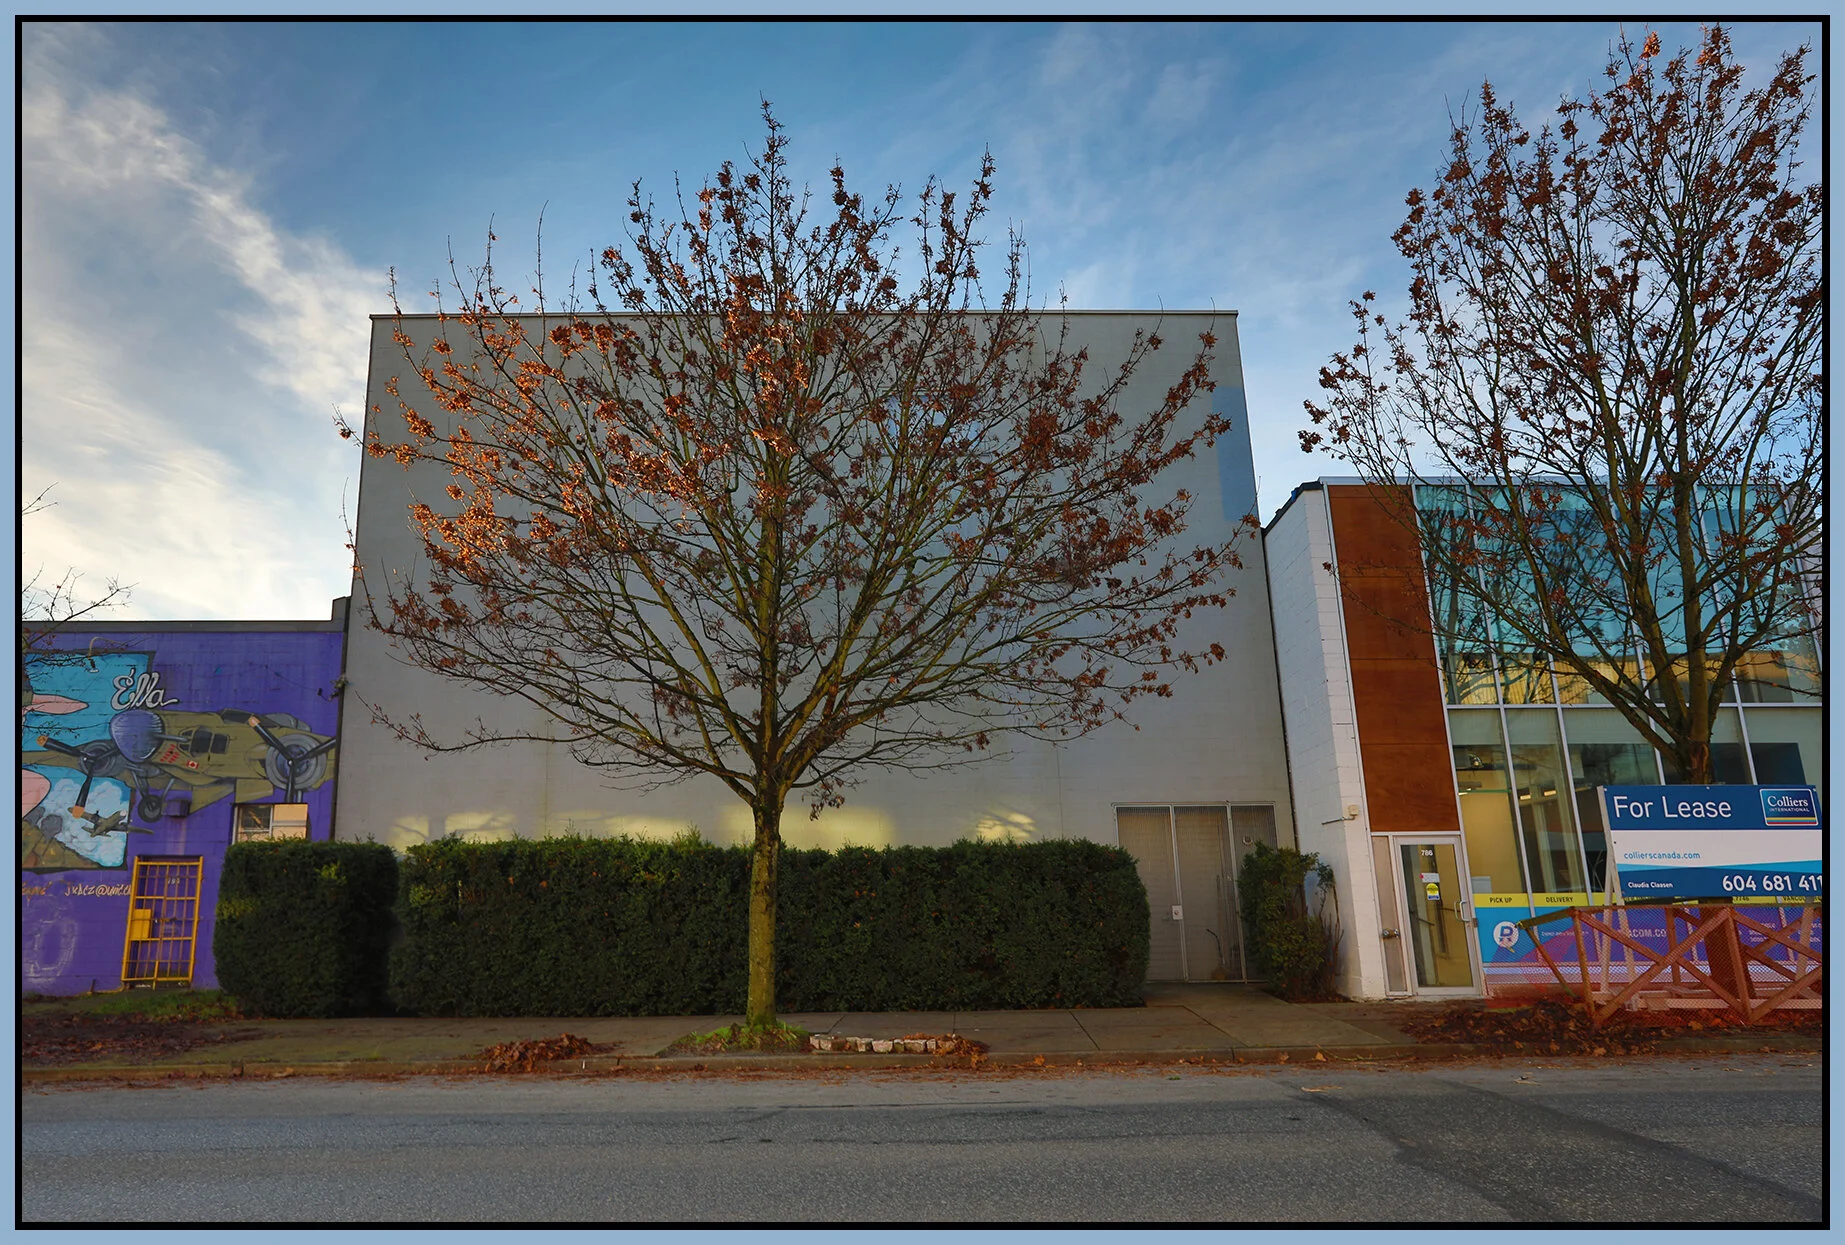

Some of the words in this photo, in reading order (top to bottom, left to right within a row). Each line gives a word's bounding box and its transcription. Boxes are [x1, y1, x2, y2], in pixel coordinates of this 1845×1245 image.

[111, 668, 179, 711] Ella
[1613, 796, 1653, 818] For
[1662, 796, 1732, 818] Lease
[1767, 795, 1808, 807] Colliers
[1623, 851, 1701, 859] collierscanada.com
[1722, 875, 1757, 891] 604
[1763, 875, 1793, 891] 681
